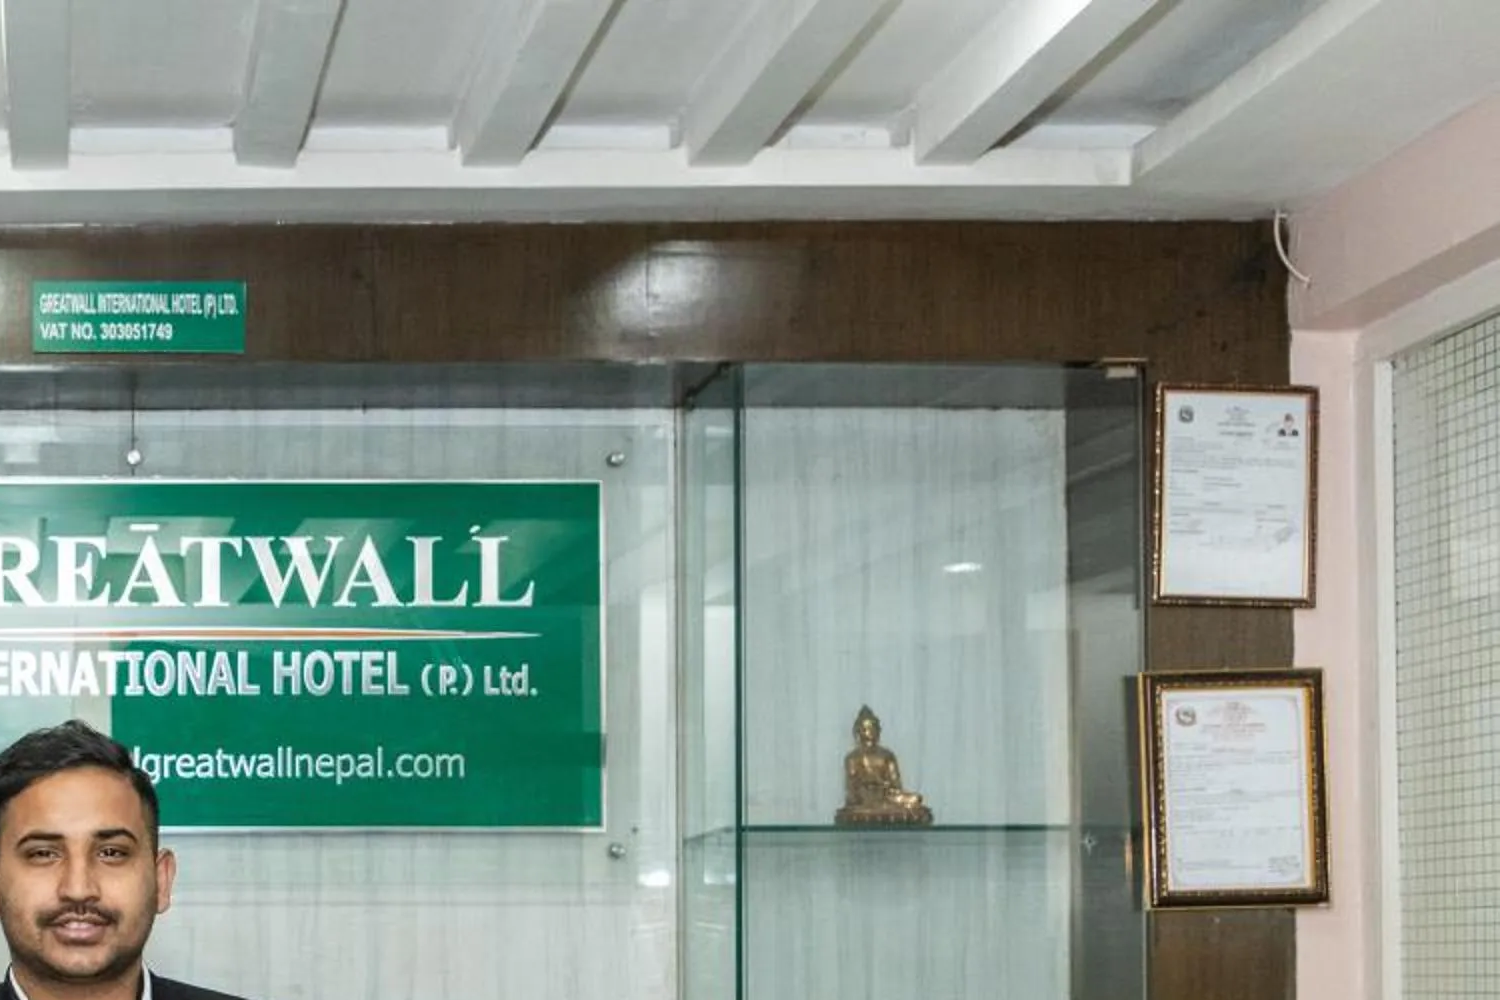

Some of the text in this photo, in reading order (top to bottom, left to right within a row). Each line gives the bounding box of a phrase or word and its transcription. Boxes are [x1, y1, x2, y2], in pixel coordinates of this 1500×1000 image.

[40, 292, 97, 315] GREATWALL
[97, 292, 171, 315] INTERNATIONAL
[171, 293, 202, 315] HOTEL
[40, 322, 173, 340] VAT NO. 303051749
[273, 650, 410, 697] HOTEL
[421, 663, 474, 697] (P.)
[483, 663, 538, 697] Ltd.
